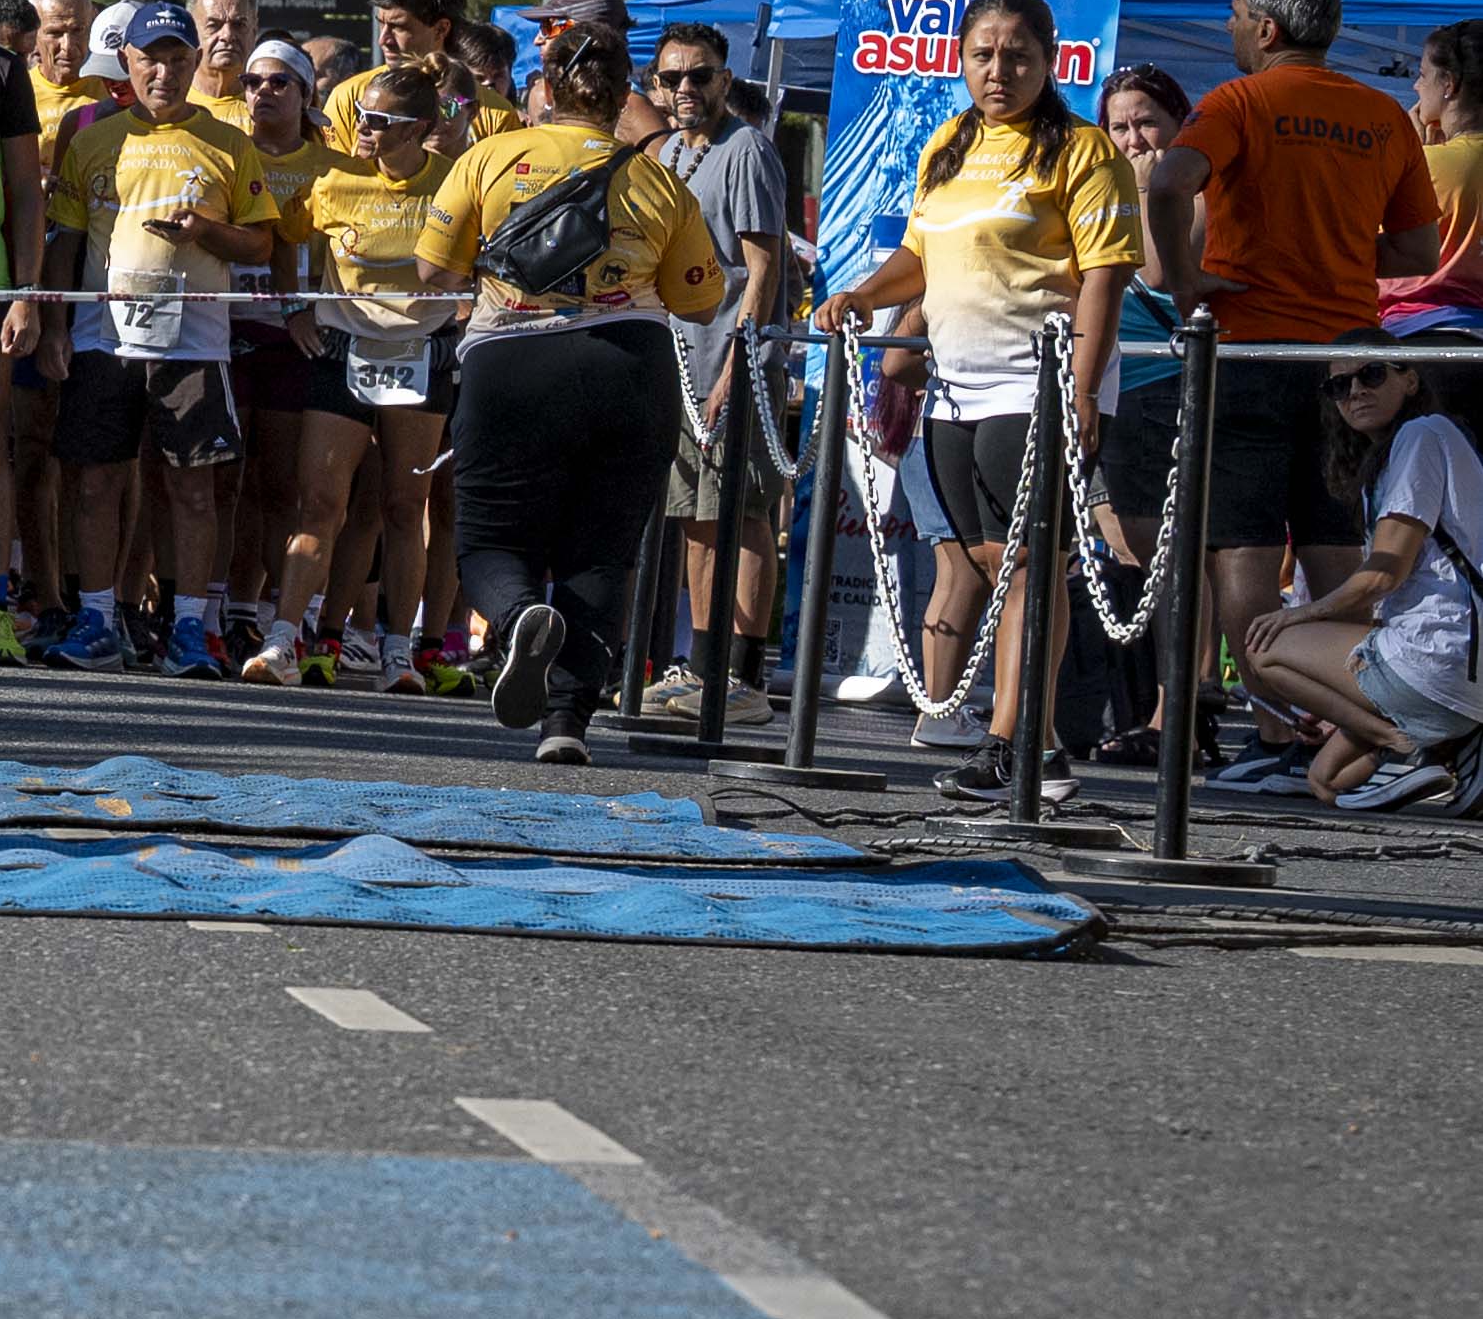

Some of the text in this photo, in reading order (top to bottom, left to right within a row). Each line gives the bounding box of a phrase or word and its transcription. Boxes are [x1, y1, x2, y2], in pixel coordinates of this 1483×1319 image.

[1274, 115, 1373, 150] CUDAIO
[124, 141, 192, 158] MARATÓN
[121, 158, 179, 171] DORADA
[123, 300, 153, 329] 72
[357, 364, 415, 390] 342
